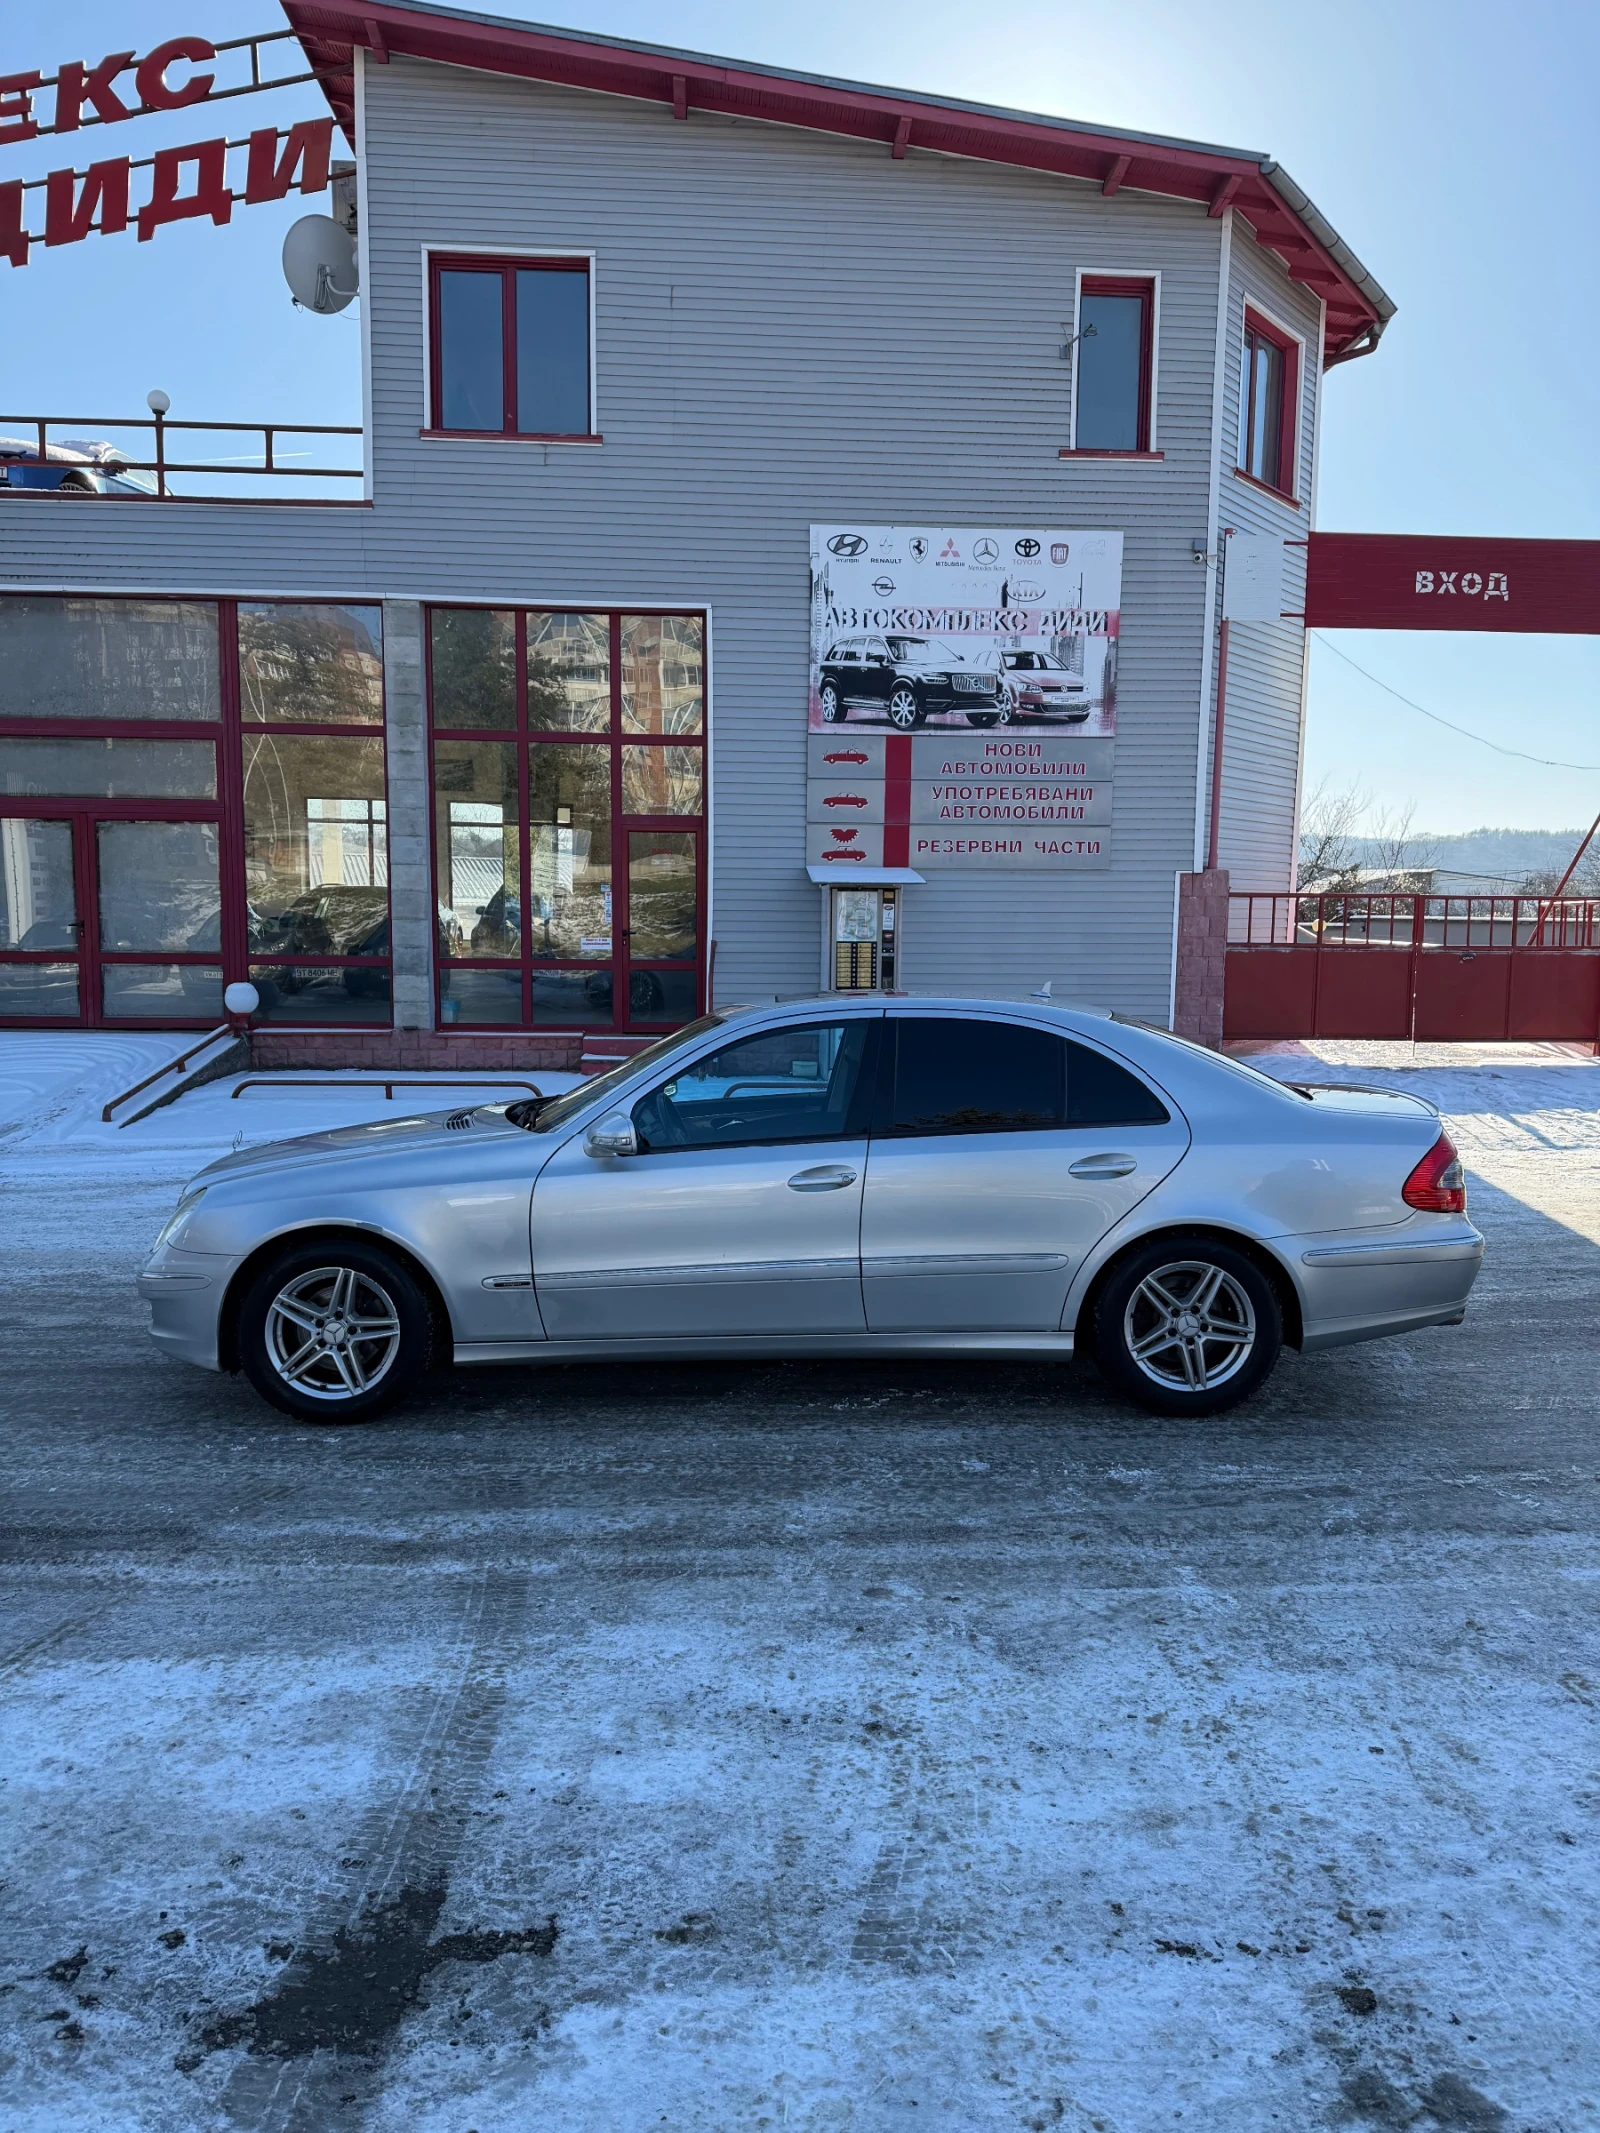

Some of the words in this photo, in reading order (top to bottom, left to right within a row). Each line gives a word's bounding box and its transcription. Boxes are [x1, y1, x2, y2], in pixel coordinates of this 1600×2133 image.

[1052, 547, 1068, 561] FIAT
[1012, 558, 1042, 566] TOYOTA
[1415, 570, 1509, 602] ВХОД
[825, 607, 1029, 632] АВТОКОМПЛЕКС
[1038, 610, 1109, 636] ДИДИ
[984, 743, 1042, 757] НОВИ
[940, 762, 1087, 776] АВТОМОБИЛИ
[931, 786, 1094, 801] УПОТРЕБЯВАНИ
[939, 805, 1085, 820] АВТОМОБИЛИ
[916, 839, 1023, 854] РЕЗЕРВНИ
[1034, 840, 1101, 855] ЧАСТИ
